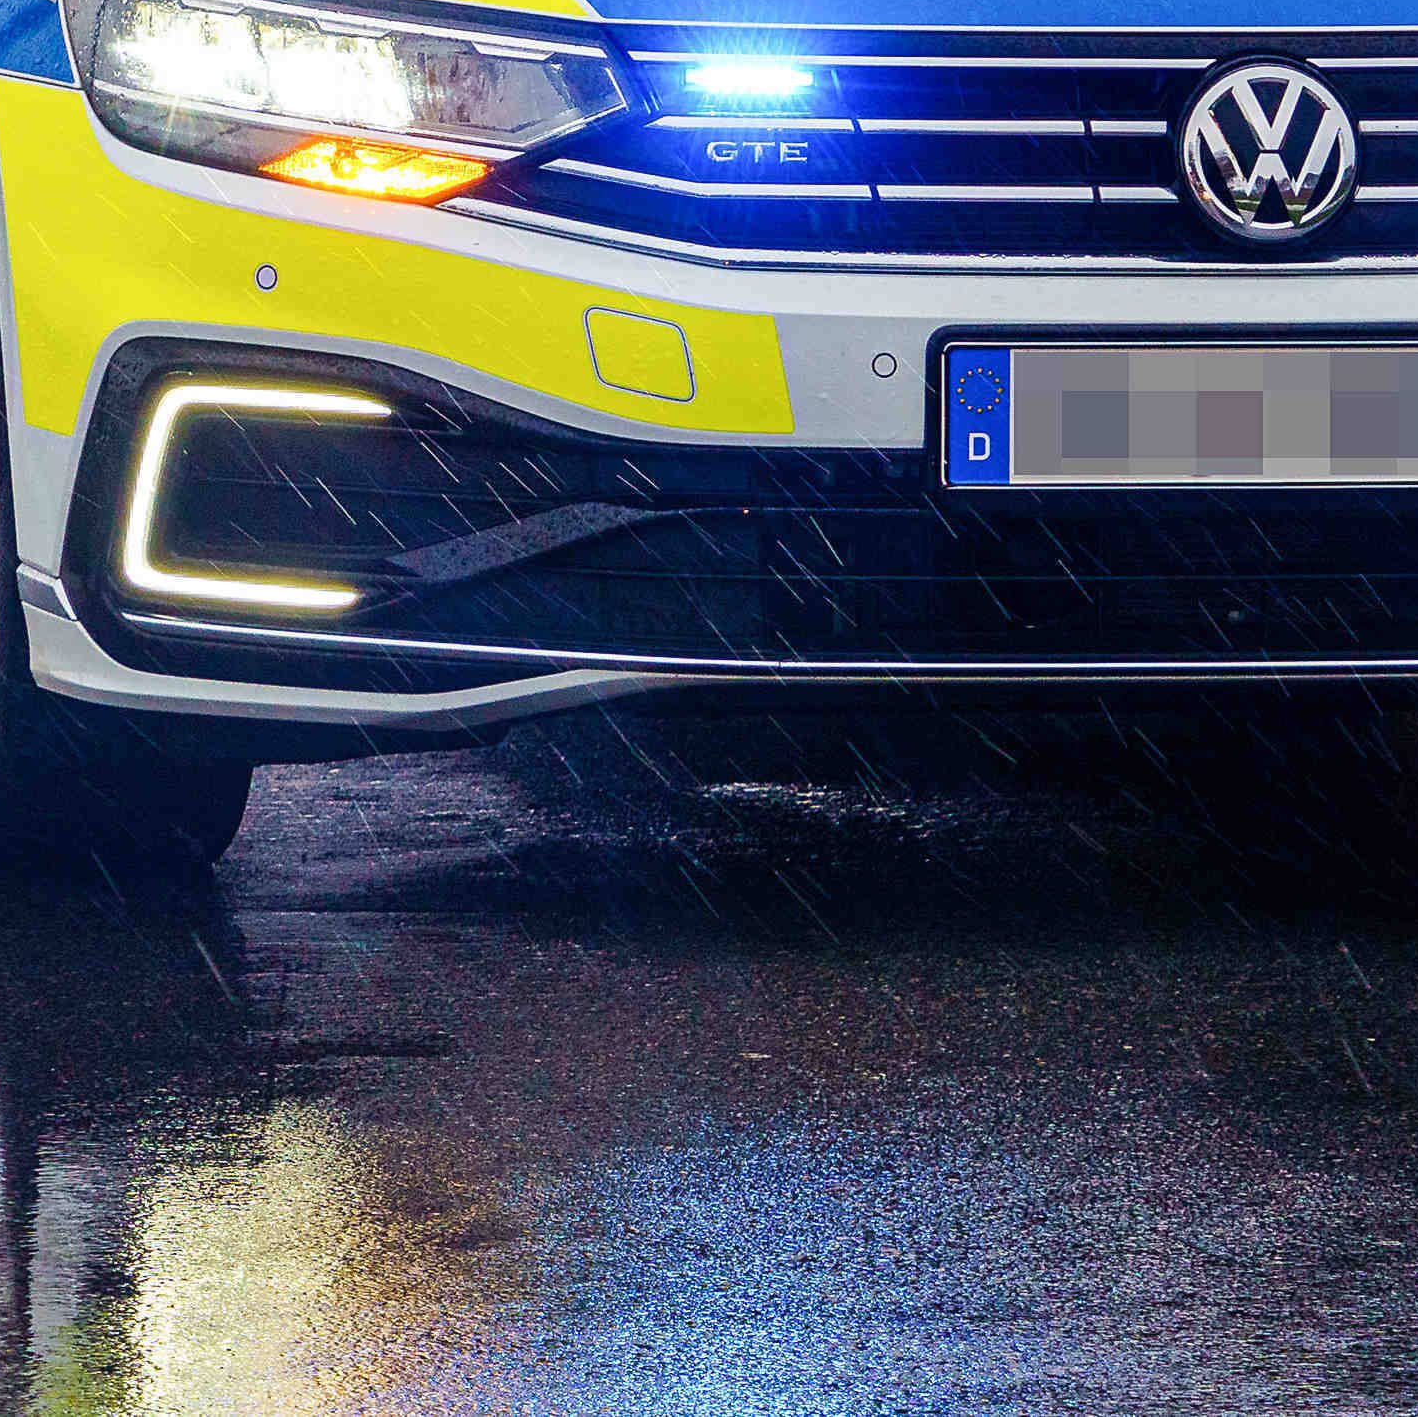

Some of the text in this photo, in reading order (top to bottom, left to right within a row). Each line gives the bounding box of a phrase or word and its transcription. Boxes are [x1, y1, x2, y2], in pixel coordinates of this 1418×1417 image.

[706, 141, 808, 164] GTE
[1184, 66, 1356, 239] VW
[968, 431, 991, 462] D
